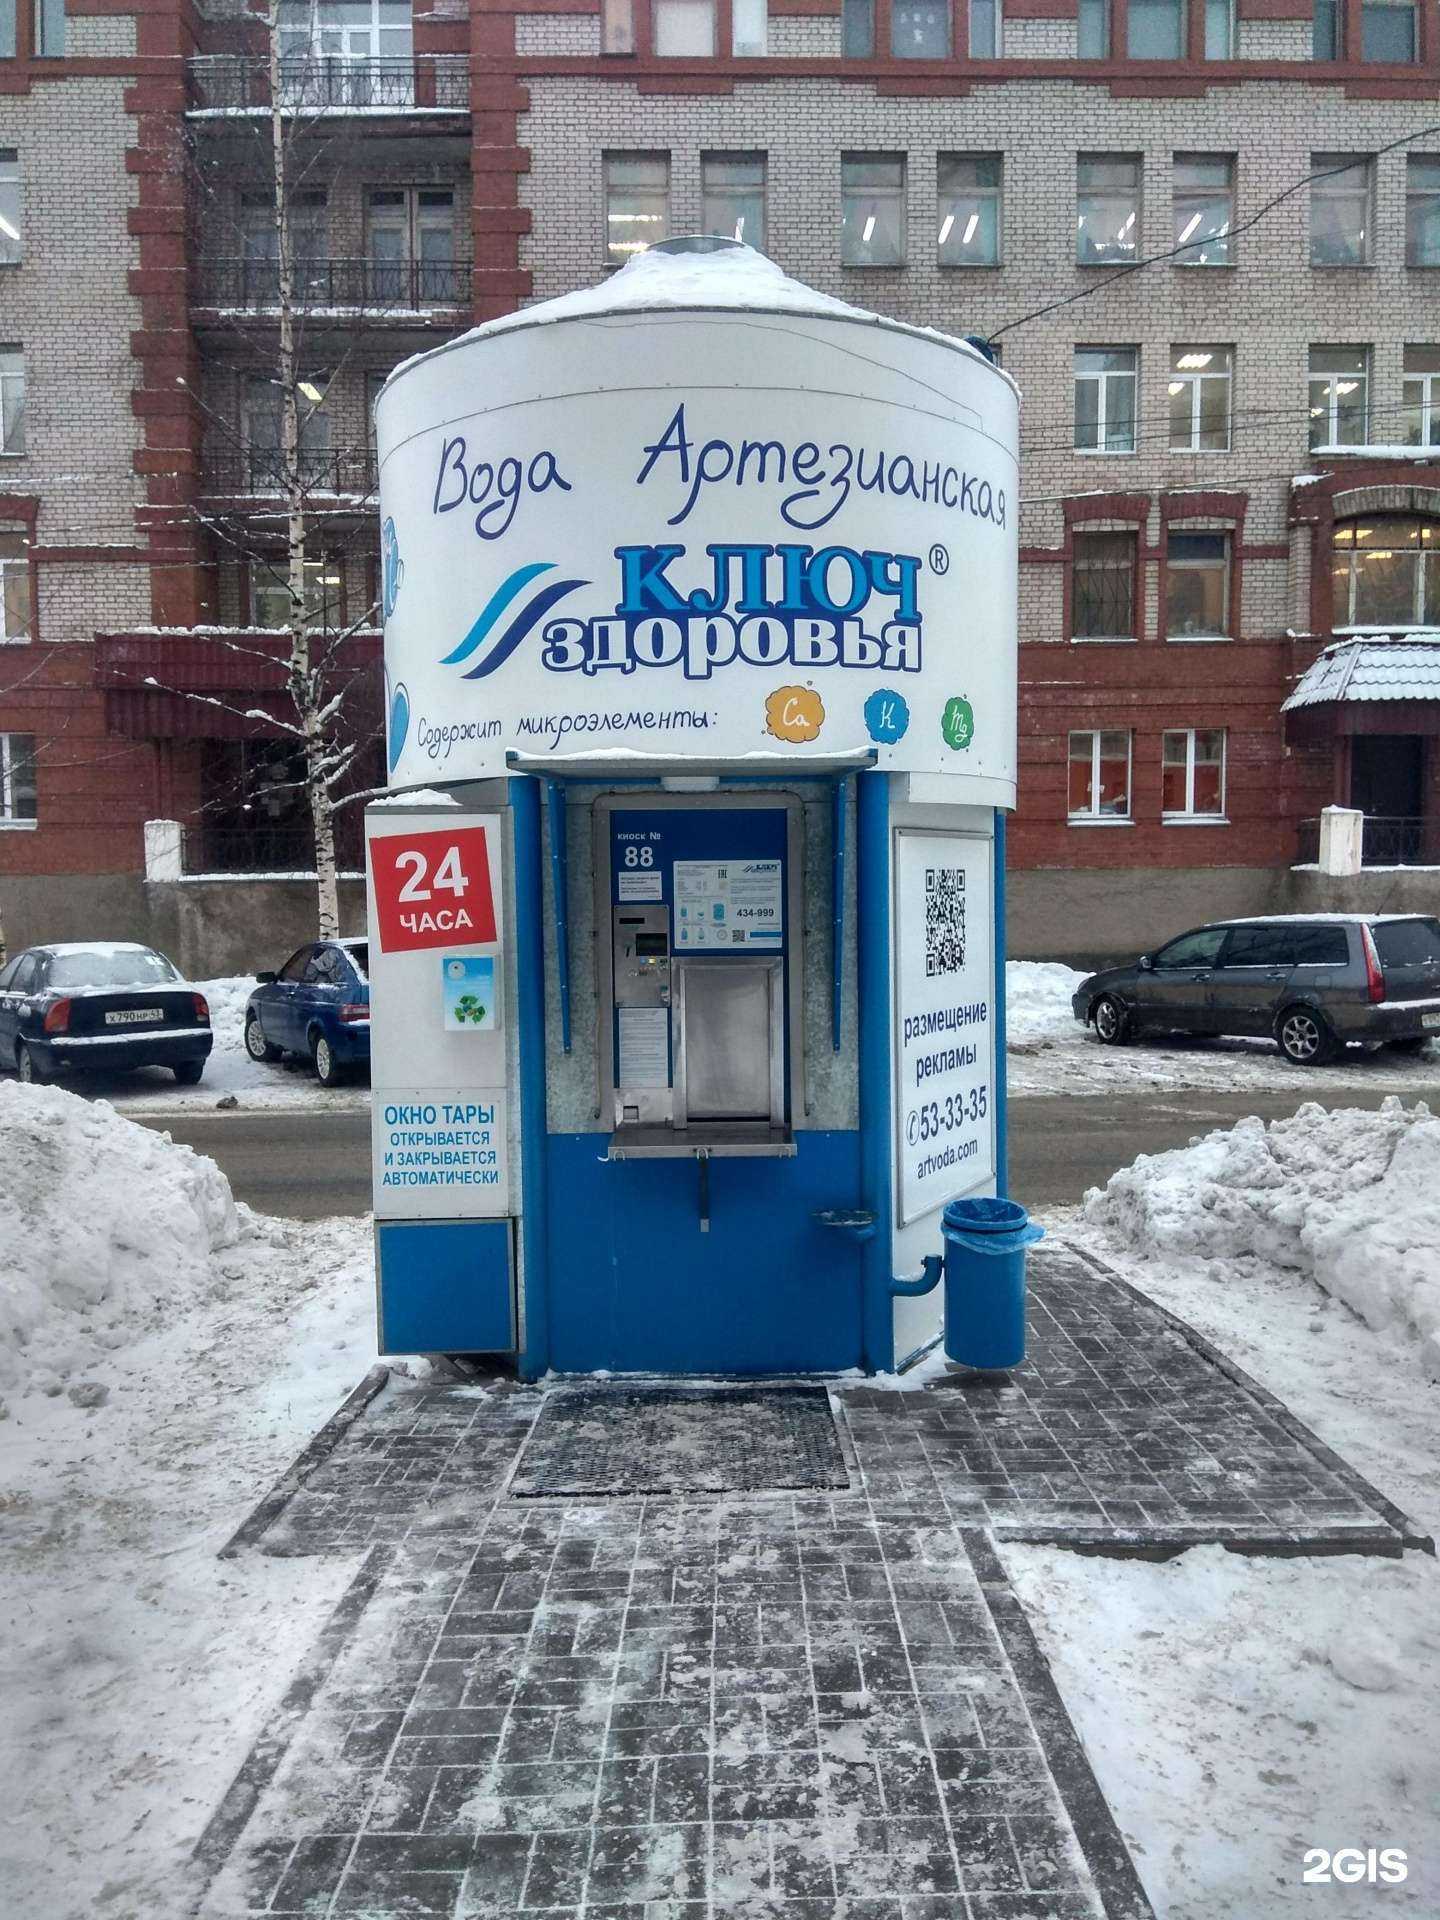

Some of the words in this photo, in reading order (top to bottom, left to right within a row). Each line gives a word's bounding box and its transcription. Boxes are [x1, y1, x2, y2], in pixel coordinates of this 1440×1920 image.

[433, 436, 572, 540] Вода
[636, 402, 1007, 529] Артезианская
[782, 697, 810, 727] Ca
[417, 717, 502, 758] Содержит
[516, 710, 718, 750] микроэлементы:
[624, 846, 654, 868] 88
[395, 846, 469, 903] 24
[399, 908, 474, 934] ЧАСА
[736, 908, 775, 918] 434-999
[904, 1002, 987, 1047] размещение
[916, 1044, 977, 1087] рекламы
[384, 1105, 437, 1125] ОКНО
[442, 1104, 494, 1124] ТАРЫ
[920, 1086, 987, 1141] 53-33-35
[390, 1130, 490, 1147] ОТКРЫВАЕТСЯ
[384, 1152, 393, 1166] И
[397, 1151, 497, 1166] ЗАКРЫВАЕТСЯ
[917, 1138, 978, 1179] artvoda.com
[382, 1170, 499, 1186] АВТОМАТИЧЕСКИ
